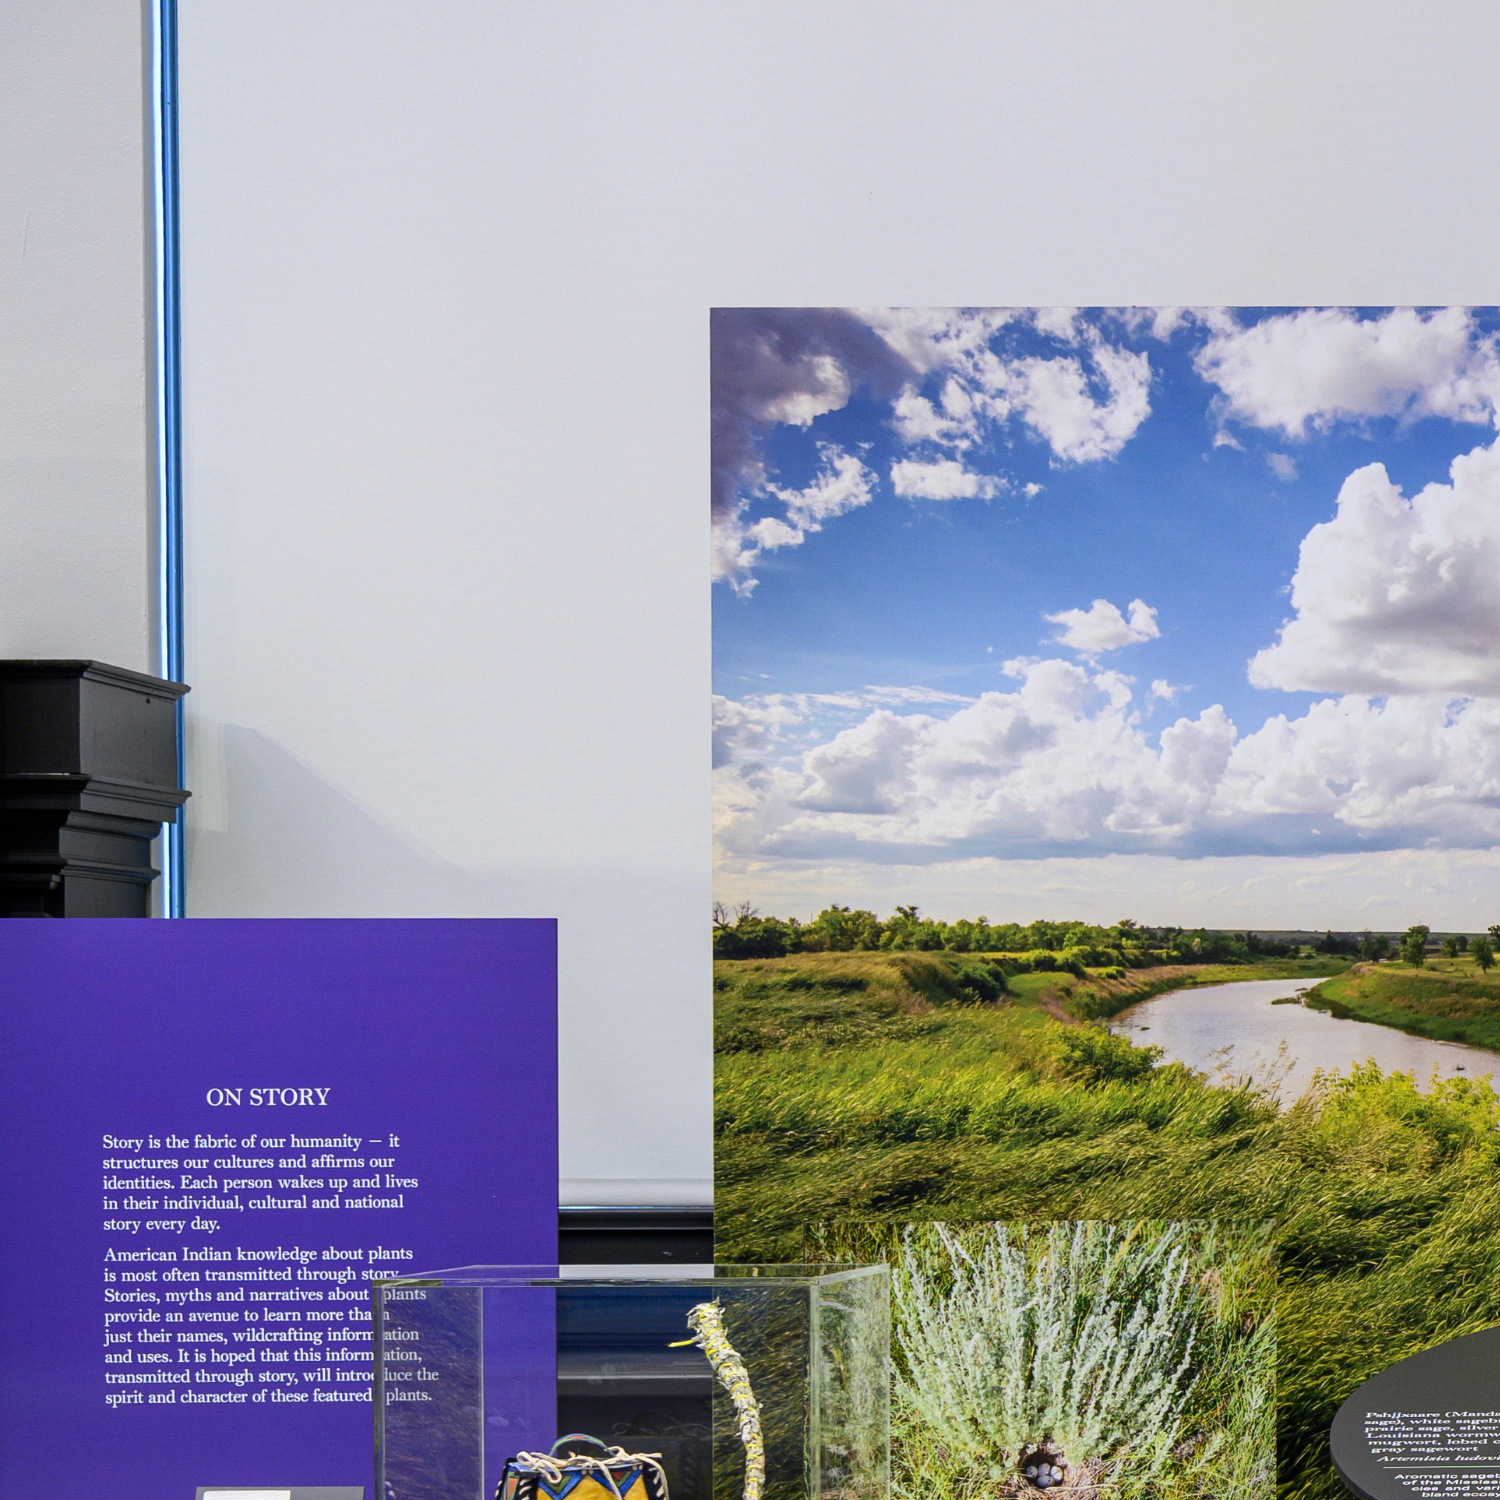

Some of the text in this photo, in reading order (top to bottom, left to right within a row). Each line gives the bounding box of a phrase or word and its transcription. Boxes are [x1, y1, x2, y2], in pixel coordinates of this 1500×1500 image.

[206, 1088, 331, 1106] ON STORY
[103, 1134, 144, 1153] Story
[148, 1134, 161, 1149] is
[165, 1134, 189, 1149] the
[194, 1134, 237, 1148] fabric
[241, 1134, 257, 1148] of
[260, 1138, 286, 1148] our
[290, 1133, 362, 1152] humanity
[389, 1133, 400, 1147] it
[103, 1154, 394, 1169] structures our cultures and affirms our
[103, 1174, 418, 1193] identities. Each person wakes up and lives
[103, 1194, 404, 1212] in their individual, cultural and national
[104, 1215, 220, 1234] story every day.
[104, 1245, 413, 1264] American Indian knowledge about plants
[104, 1268, 116, 1282] is
[121, 1270, 158, 1282] most
[162, 1267, 200, 1281] often
[205, 1266, 292, 1281] transmitted
[296, 1266, 357, 1285] through
[1364, 1418, 1405, 1426] sage),
[1364, 1425, 1414, 1433] prairie
